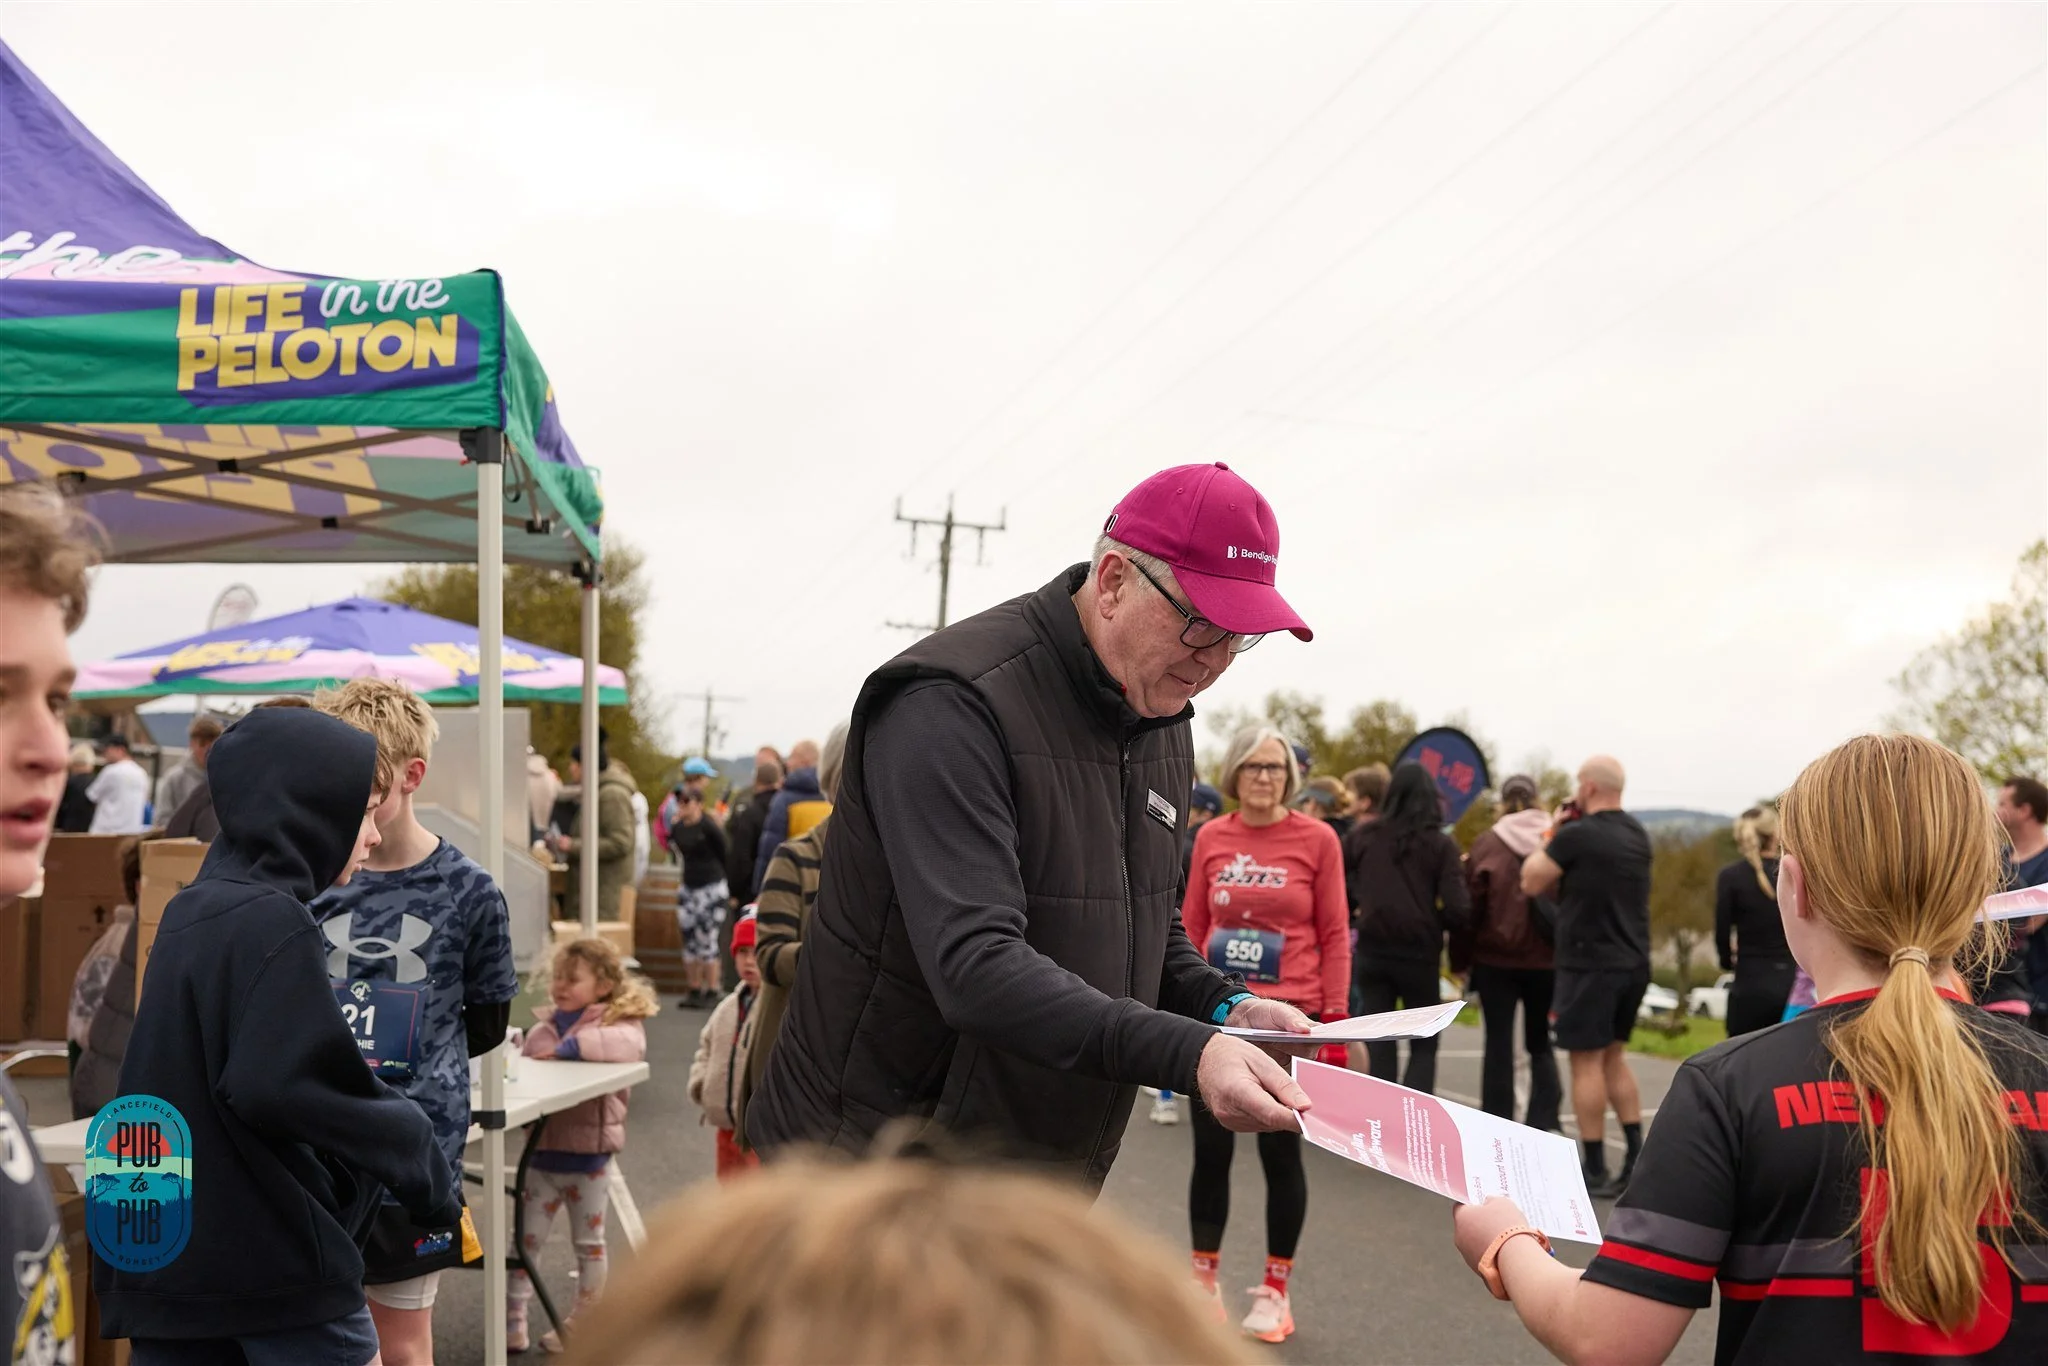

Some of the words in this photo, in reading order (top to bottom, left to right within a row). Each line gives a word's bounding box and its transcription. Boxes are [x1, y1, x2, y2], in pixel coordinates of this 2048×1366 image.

[176, 283, 306, 338] LIFE
[319, 280, 367, 318] in
[376, 278, 449, 311] the
[176, 314, 458, 391] PELOTON
[1241, 548, 1271, 563] Bendigo
[1225, 939, 1264, 962] 550
[1493, 1138, 1503, 1162] Voucher
